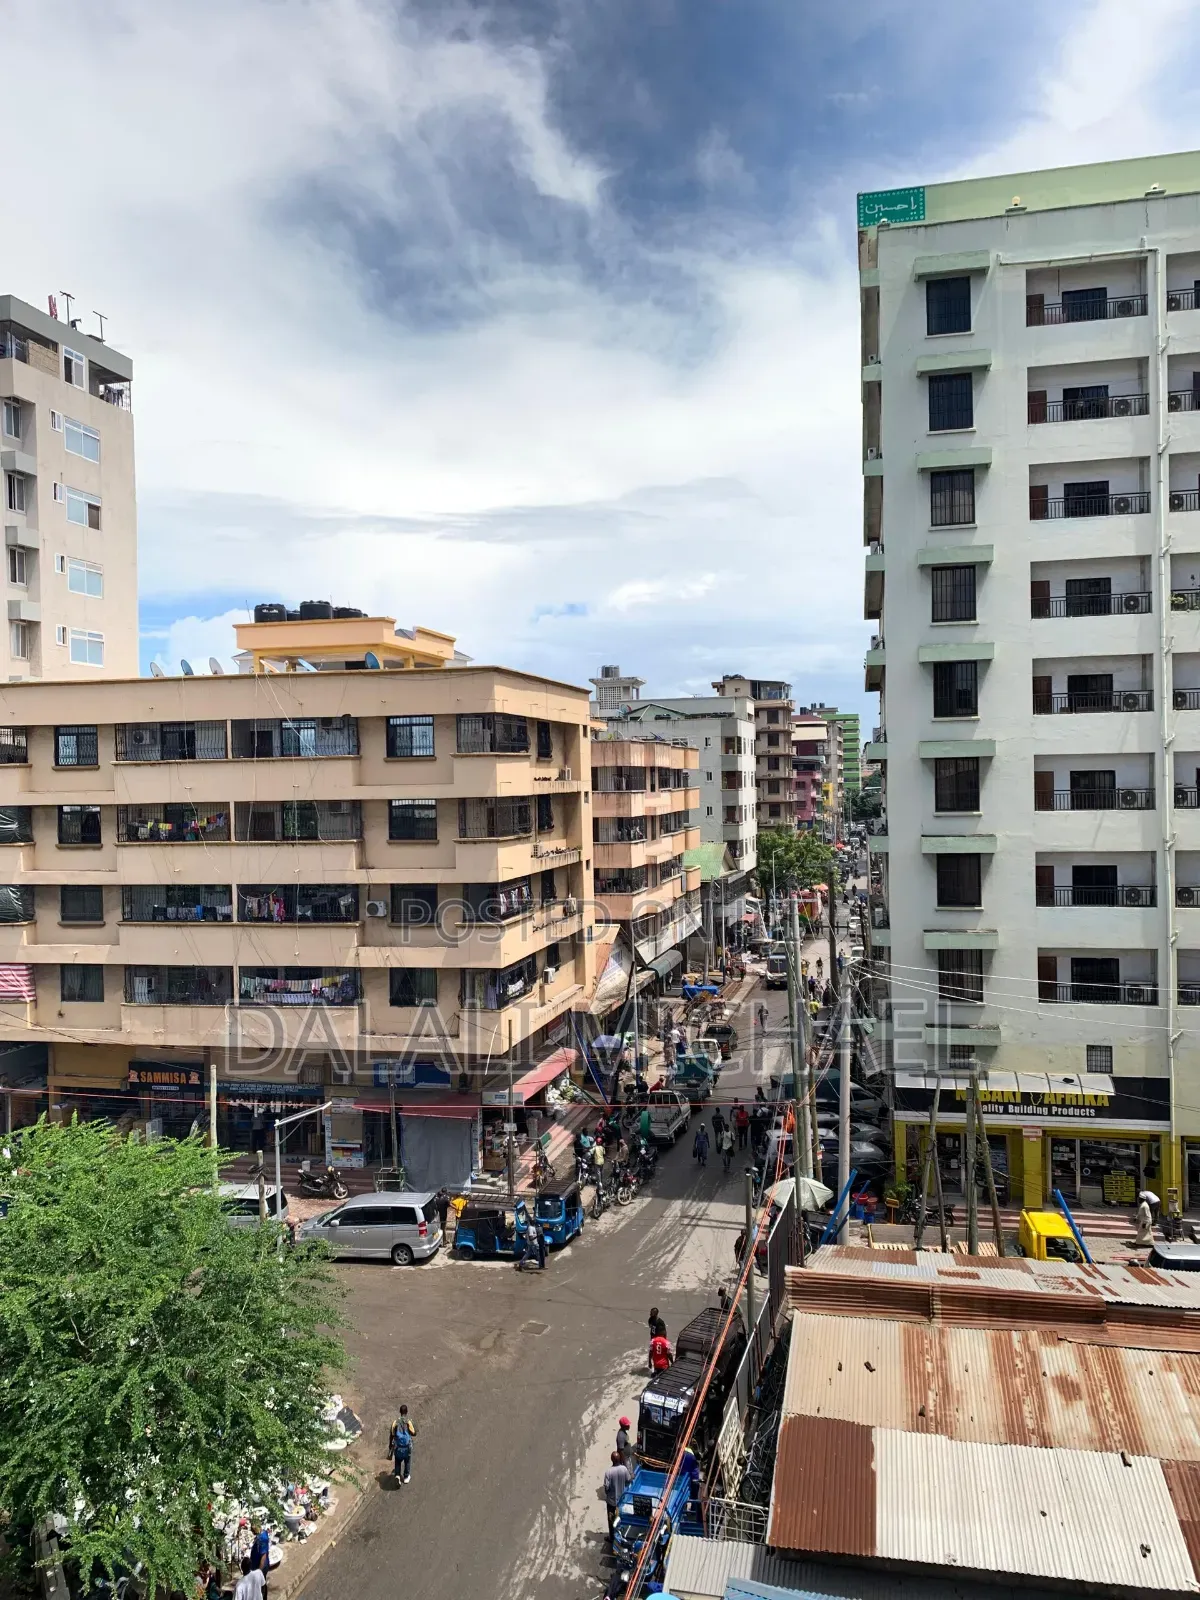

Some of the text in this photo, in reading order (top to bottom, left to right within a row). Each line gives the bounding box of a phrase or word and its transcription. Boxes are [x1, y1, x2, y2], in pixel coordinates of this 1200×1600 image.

[140, 1071, 187, 1084] SAMMISA
[955, 1089, 1110, 1106] NBAKI AFRIKA
[982, 1104, 1096, 1117] ality Building Products
